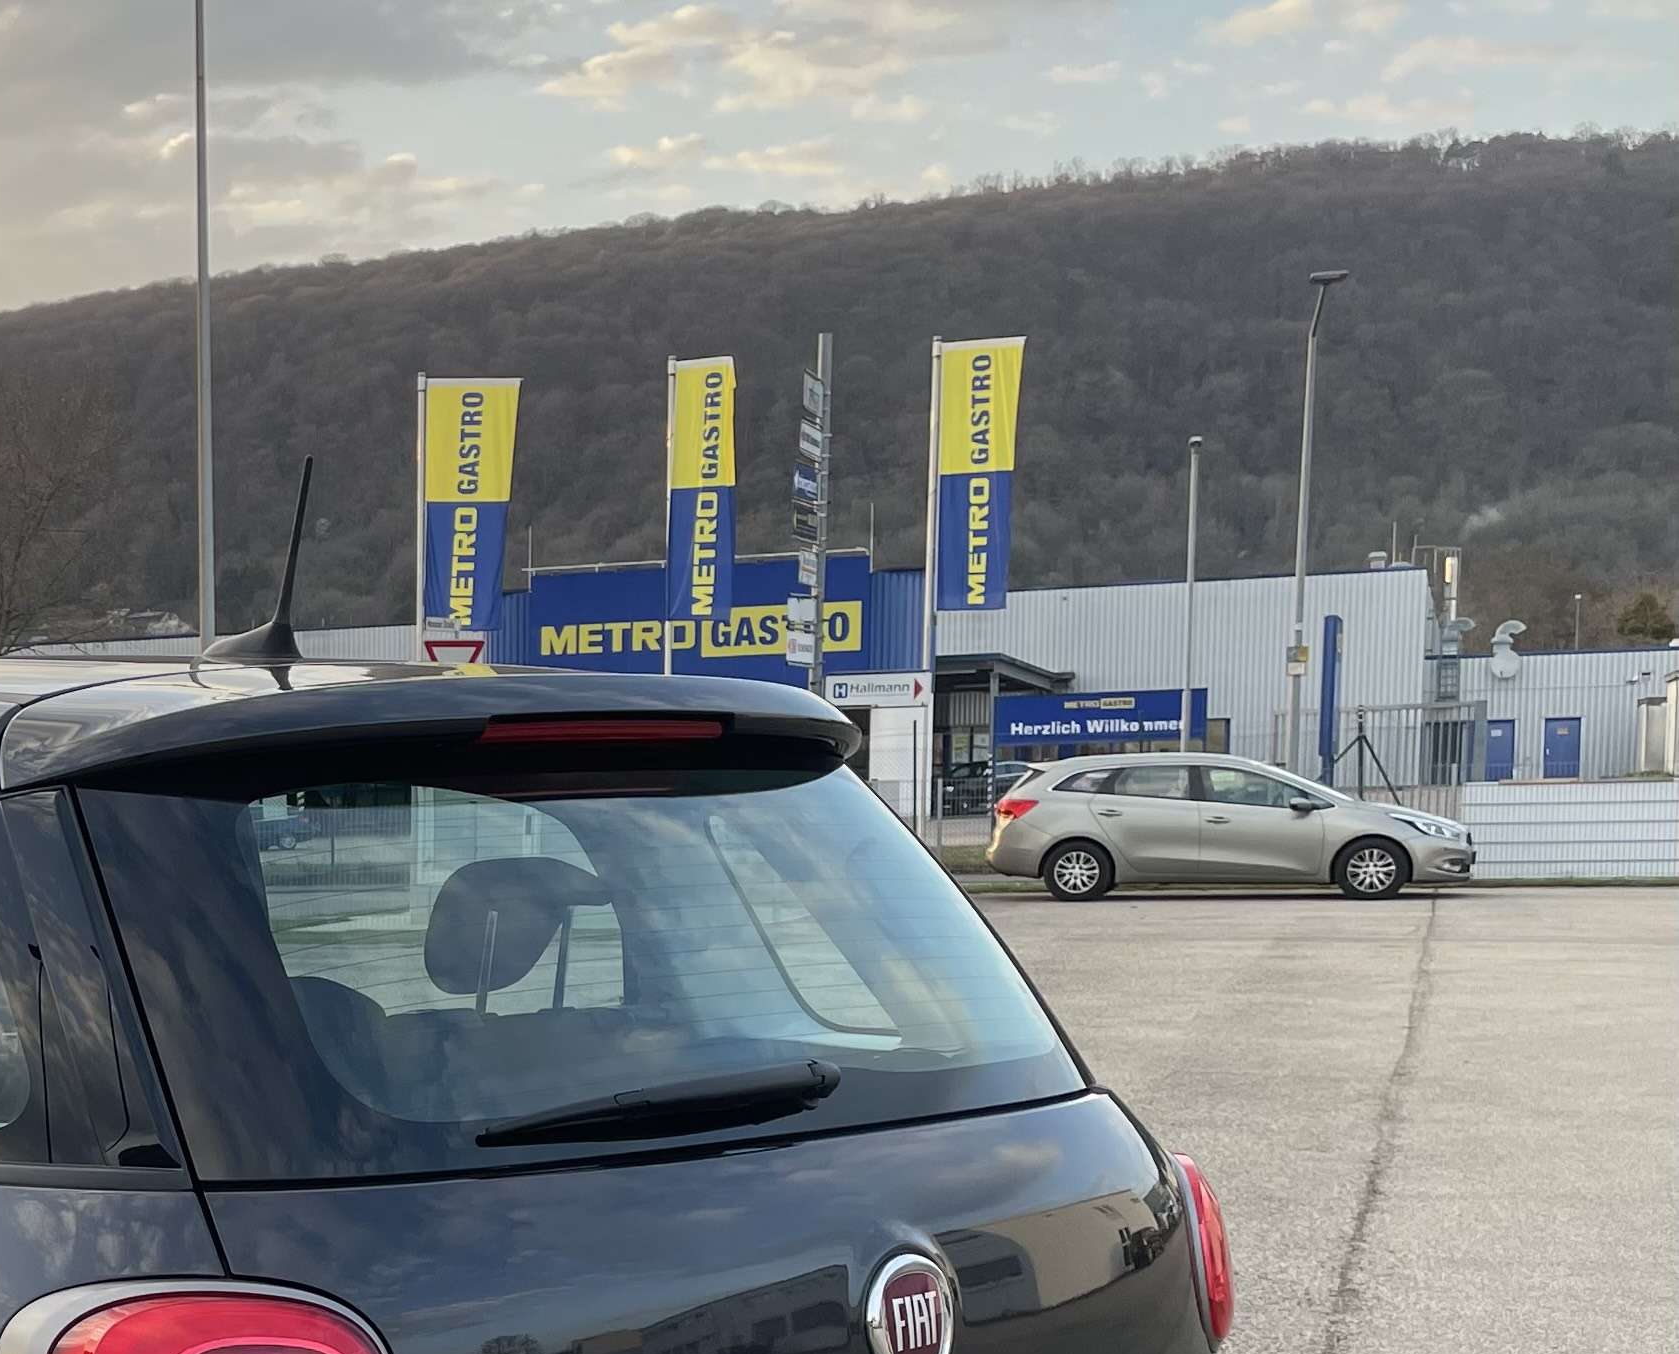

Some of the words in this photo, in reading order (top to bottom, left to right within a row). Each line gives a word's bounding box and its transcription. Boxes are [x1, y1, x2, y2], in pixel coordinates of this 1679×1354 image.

[457, 392, 484, 495] GASTRO
[701, 371, 722, 479] GASTRO
[971, 354, 992, 465] GASTRO
[449, 507, 478, 626] METRO
[692, 491, 718, 616] METRO
[967, 477, 990, 605] METRO
[540, 620, 696, 656] METRO
[711, 612, 850, 648] GASO
[850, 683, 910, 694] Hallmann
[1010, 720, 1081, 736] Herzlich
[892, 1291, 937, 1352] FIAT
